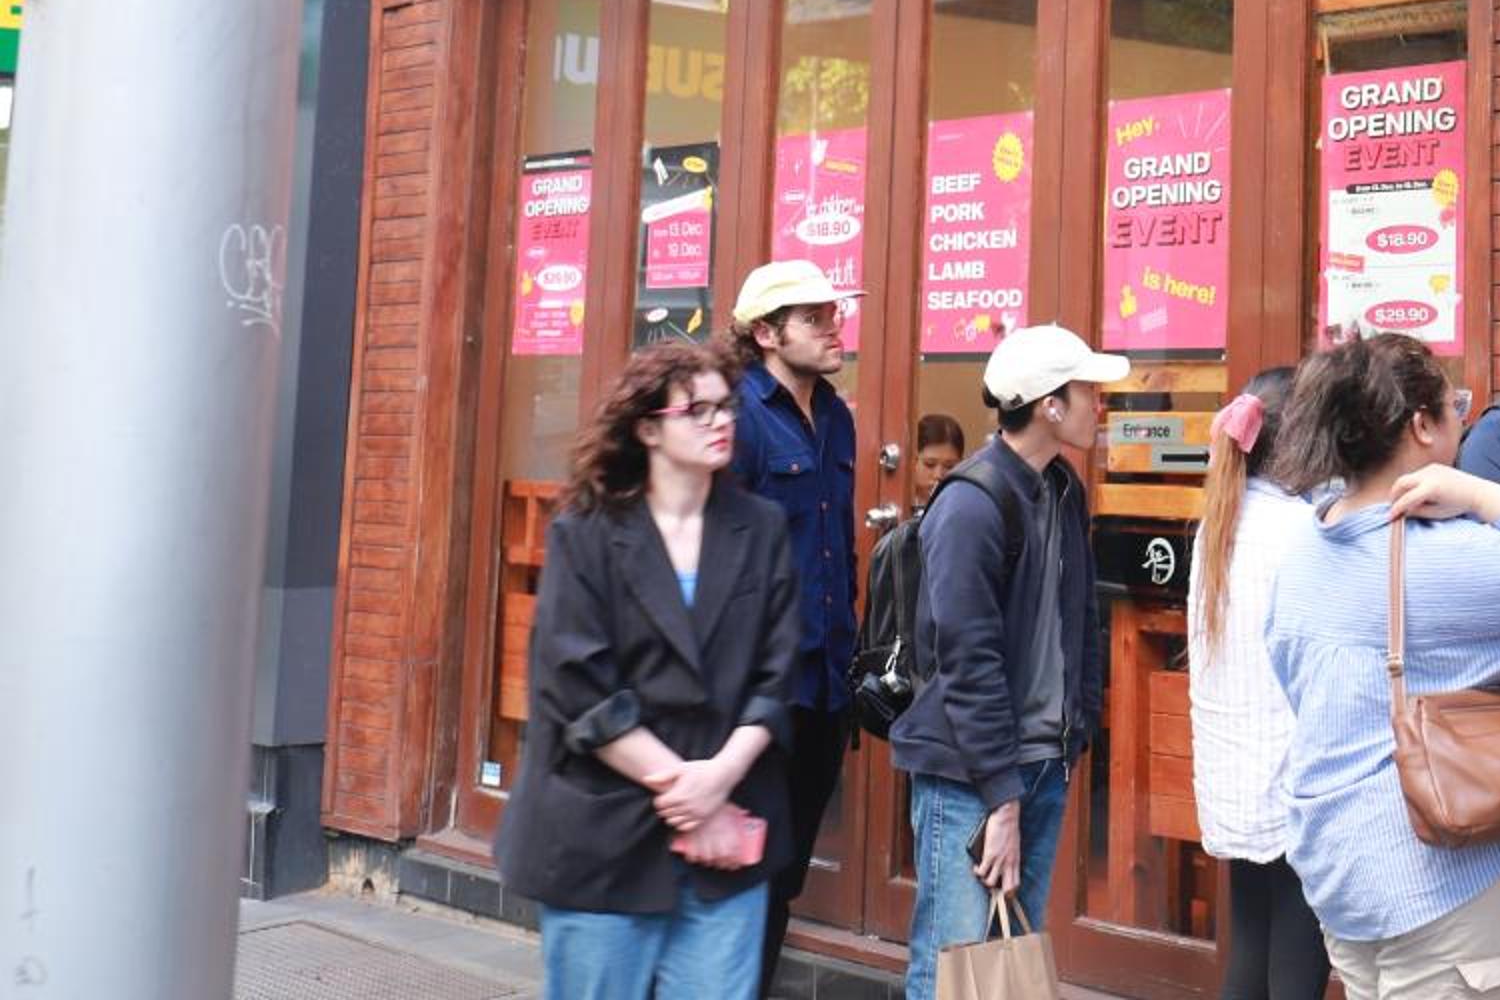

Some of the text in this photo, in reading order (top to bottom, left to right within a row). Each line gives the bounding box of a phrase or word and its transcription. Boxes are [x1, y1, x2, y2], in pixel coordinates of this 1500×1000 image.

[1341, 77, 1444, 110] GRAND
[1328, 107, 1457, 142] OPENING
[1124, 152, 1211, 180] GRAND
[1345, 139, 1440, 171] EVENT
[531, 175, 583, 196] GRAND
[931, 173, 981, 194] BEEF
[1111, 180, 1222, 209] OPENING
[525, 198, 589, 217] OPENING
[931, 202, 985, 224] PORK
[930, 229, 1017, 252] CHICKEN
[1112, 212, 1222, 249] EVENT
[1377, 230, 1428, 249] $18.90
[928, 260, 985, 281] LAMB
[1143, 265, 1216, 306] is here!
[928, 289, 1022, 309] SEAFOOD
